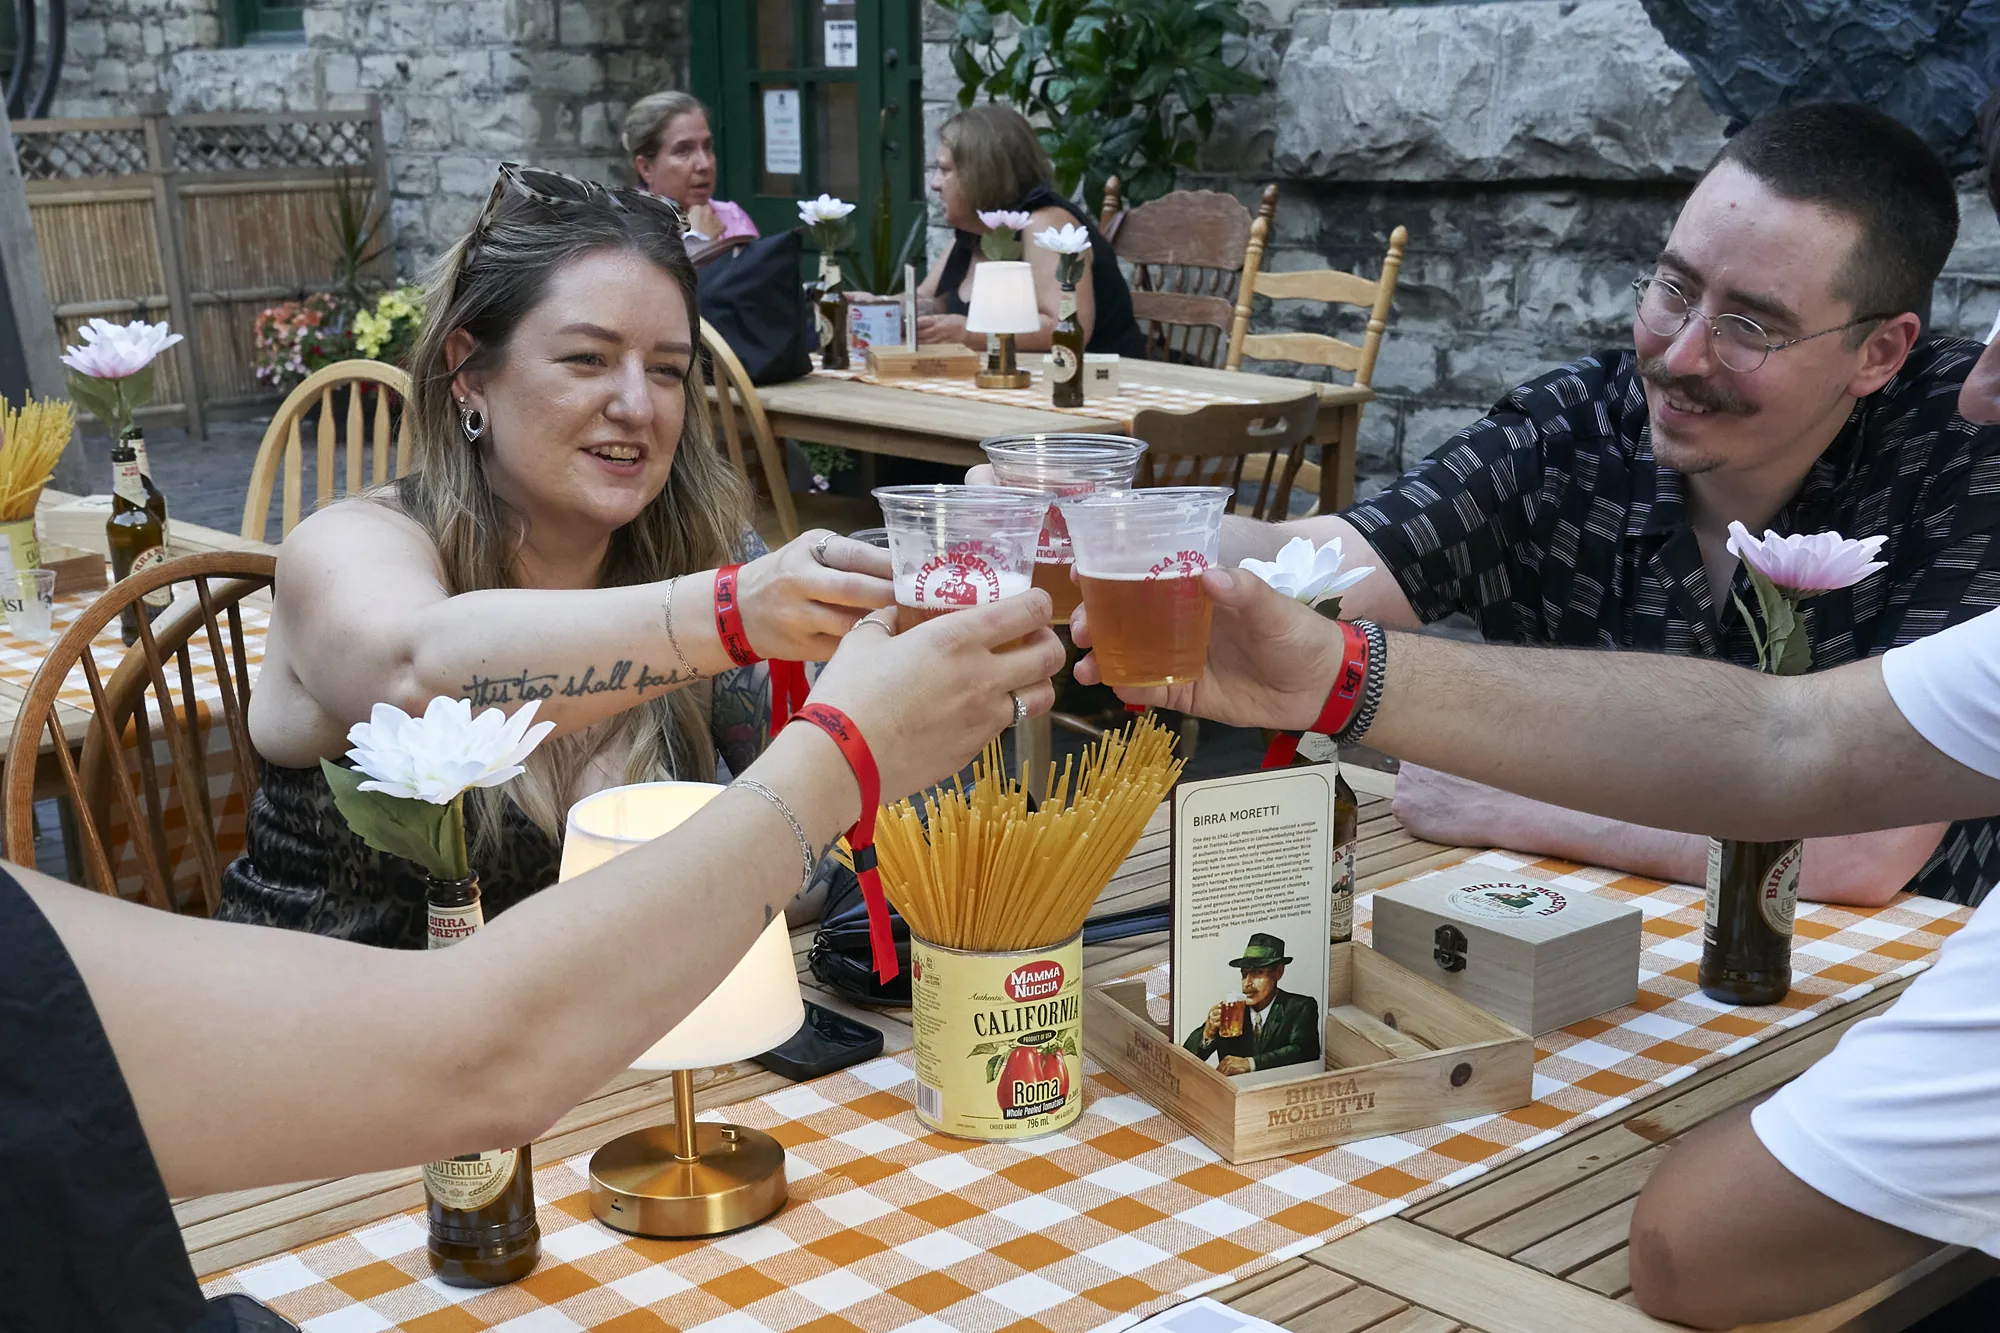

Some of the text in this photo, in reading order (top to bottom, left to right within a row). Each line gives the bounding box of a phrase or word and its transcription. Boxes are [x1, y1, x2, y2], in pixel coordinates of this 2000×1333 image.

[915, 555, 946, 602] BIRRA
[561, 660, 633, 697] shall
[1193, 805, 1279, 826] BIRRA MORETTI
[1766, 848, 1800, 899] BIRRA
[1460, 883, 1528, 893] BIRRA
[1530, 886, 1567, 916] MORETTI
[430, 916, 467, 927] BIRRA
[1011, 967, 1060, 985] MAMMA
[1015, 982, 1058, 998] NUCCIA
[974, 994, 1078, 1037] CALIFORNIA
[1023, 1035, 1040, 1043] PRODUCT
[1134, 1030, 1171, 1071] BIRRA
[1126, 1042, 1181, 1097] MORETTI
[1014, 1079, 1058, 1105] Roma
[1285, 1079, 1359, 1106] BIRRA
[1006, 1097, 1064, 1117] Whole Peeled Tomatoes
[1267, 1092, 1376, 1128] MORETTI
[1027, 1118, 1038, 1129] 796
[426, 1162, 492, 1176] AUTENTICA
